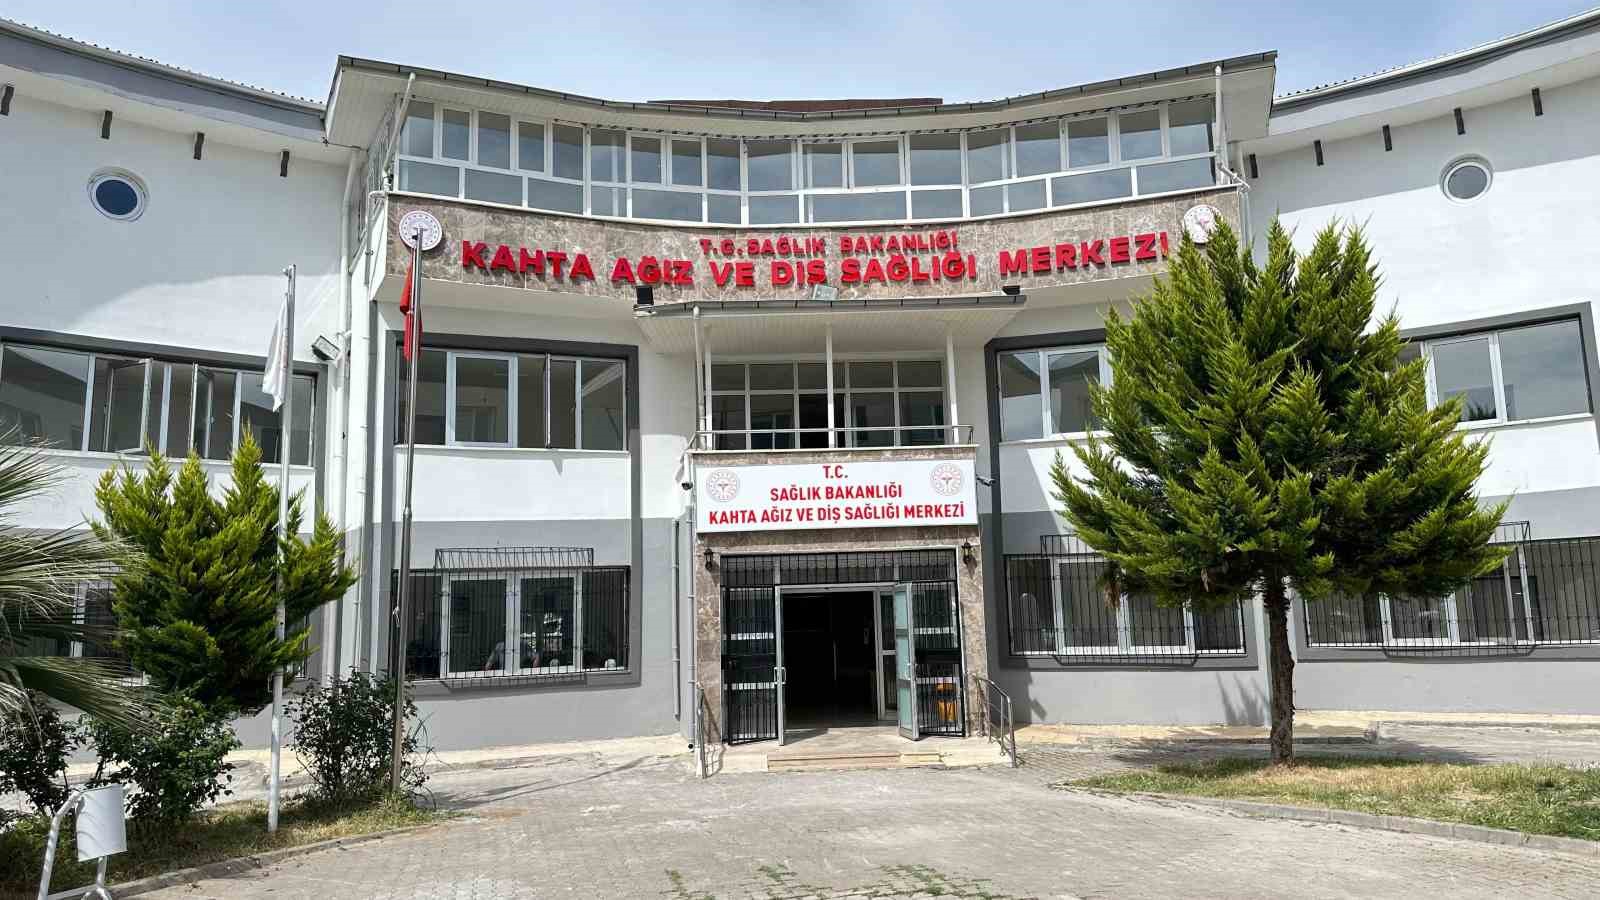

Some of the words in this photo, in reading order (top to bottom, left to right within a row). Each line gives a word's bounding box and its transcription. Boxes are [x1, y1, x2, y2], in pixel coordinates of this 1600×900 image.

[840, 229, 958, 254] BAKANLIĞI
[460, 240, 596, 279] KAHTA
[610, 255, 694, 286] AĞIZ
[708, 260, 754, 288] VE
[840, 250, 977, 284] SAĞLIĞI
[822, 465, 849, 480] T.C.
[770, 484, 821, 501] SAĞLIK
[825, 483, 903, 500] BAKANLIĞI
[709, 510, 757, 525] KAHTA
[760, 506, 793, 523] AĞIZ
[796, 508, 814, 522] VE
[817, 503, 841, 524] DİŞ
[844, 503, 900, 520] SAĞLIĞI
[903, 501, 965, 518] MERKEZİ
